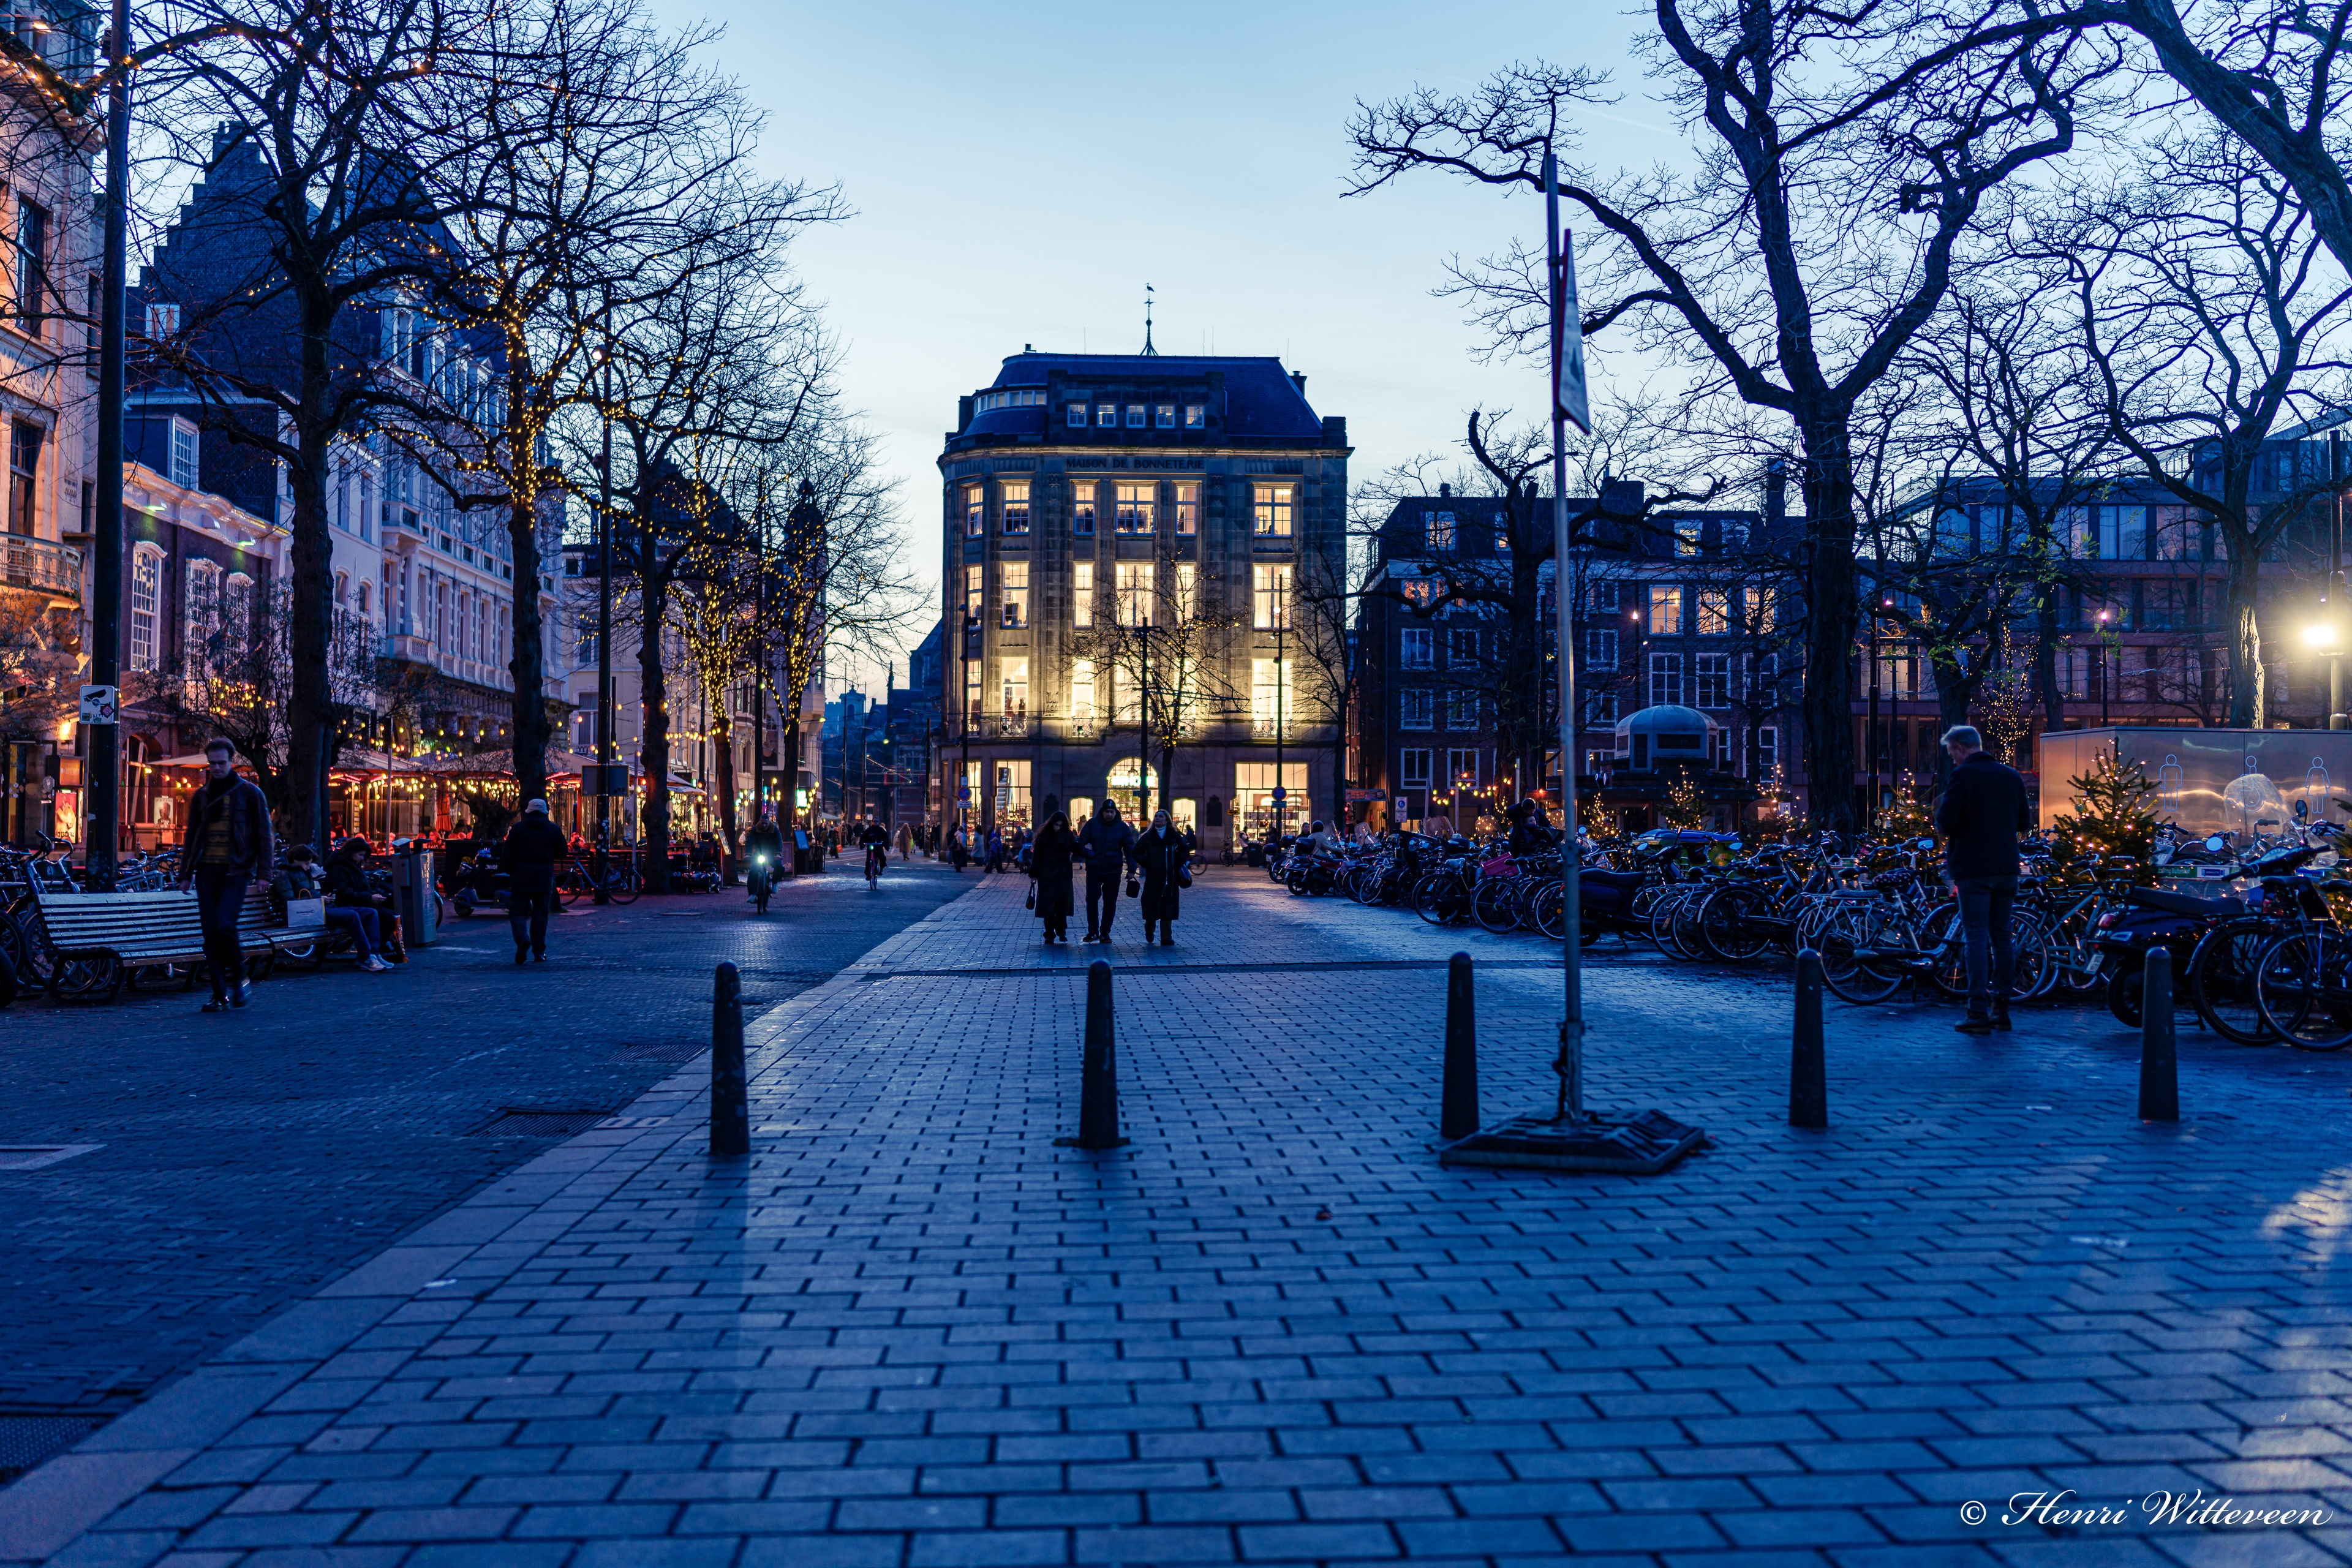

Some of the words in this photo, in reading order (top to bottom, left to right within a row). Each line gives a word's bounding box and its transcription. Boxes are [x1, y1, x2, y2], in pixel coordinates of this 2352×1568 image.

[1066, 459, 1107, 468] MAISON
[1113, 459, 1128, 469] DE
[1134, 459, 1205, 469] BONNETERIE
